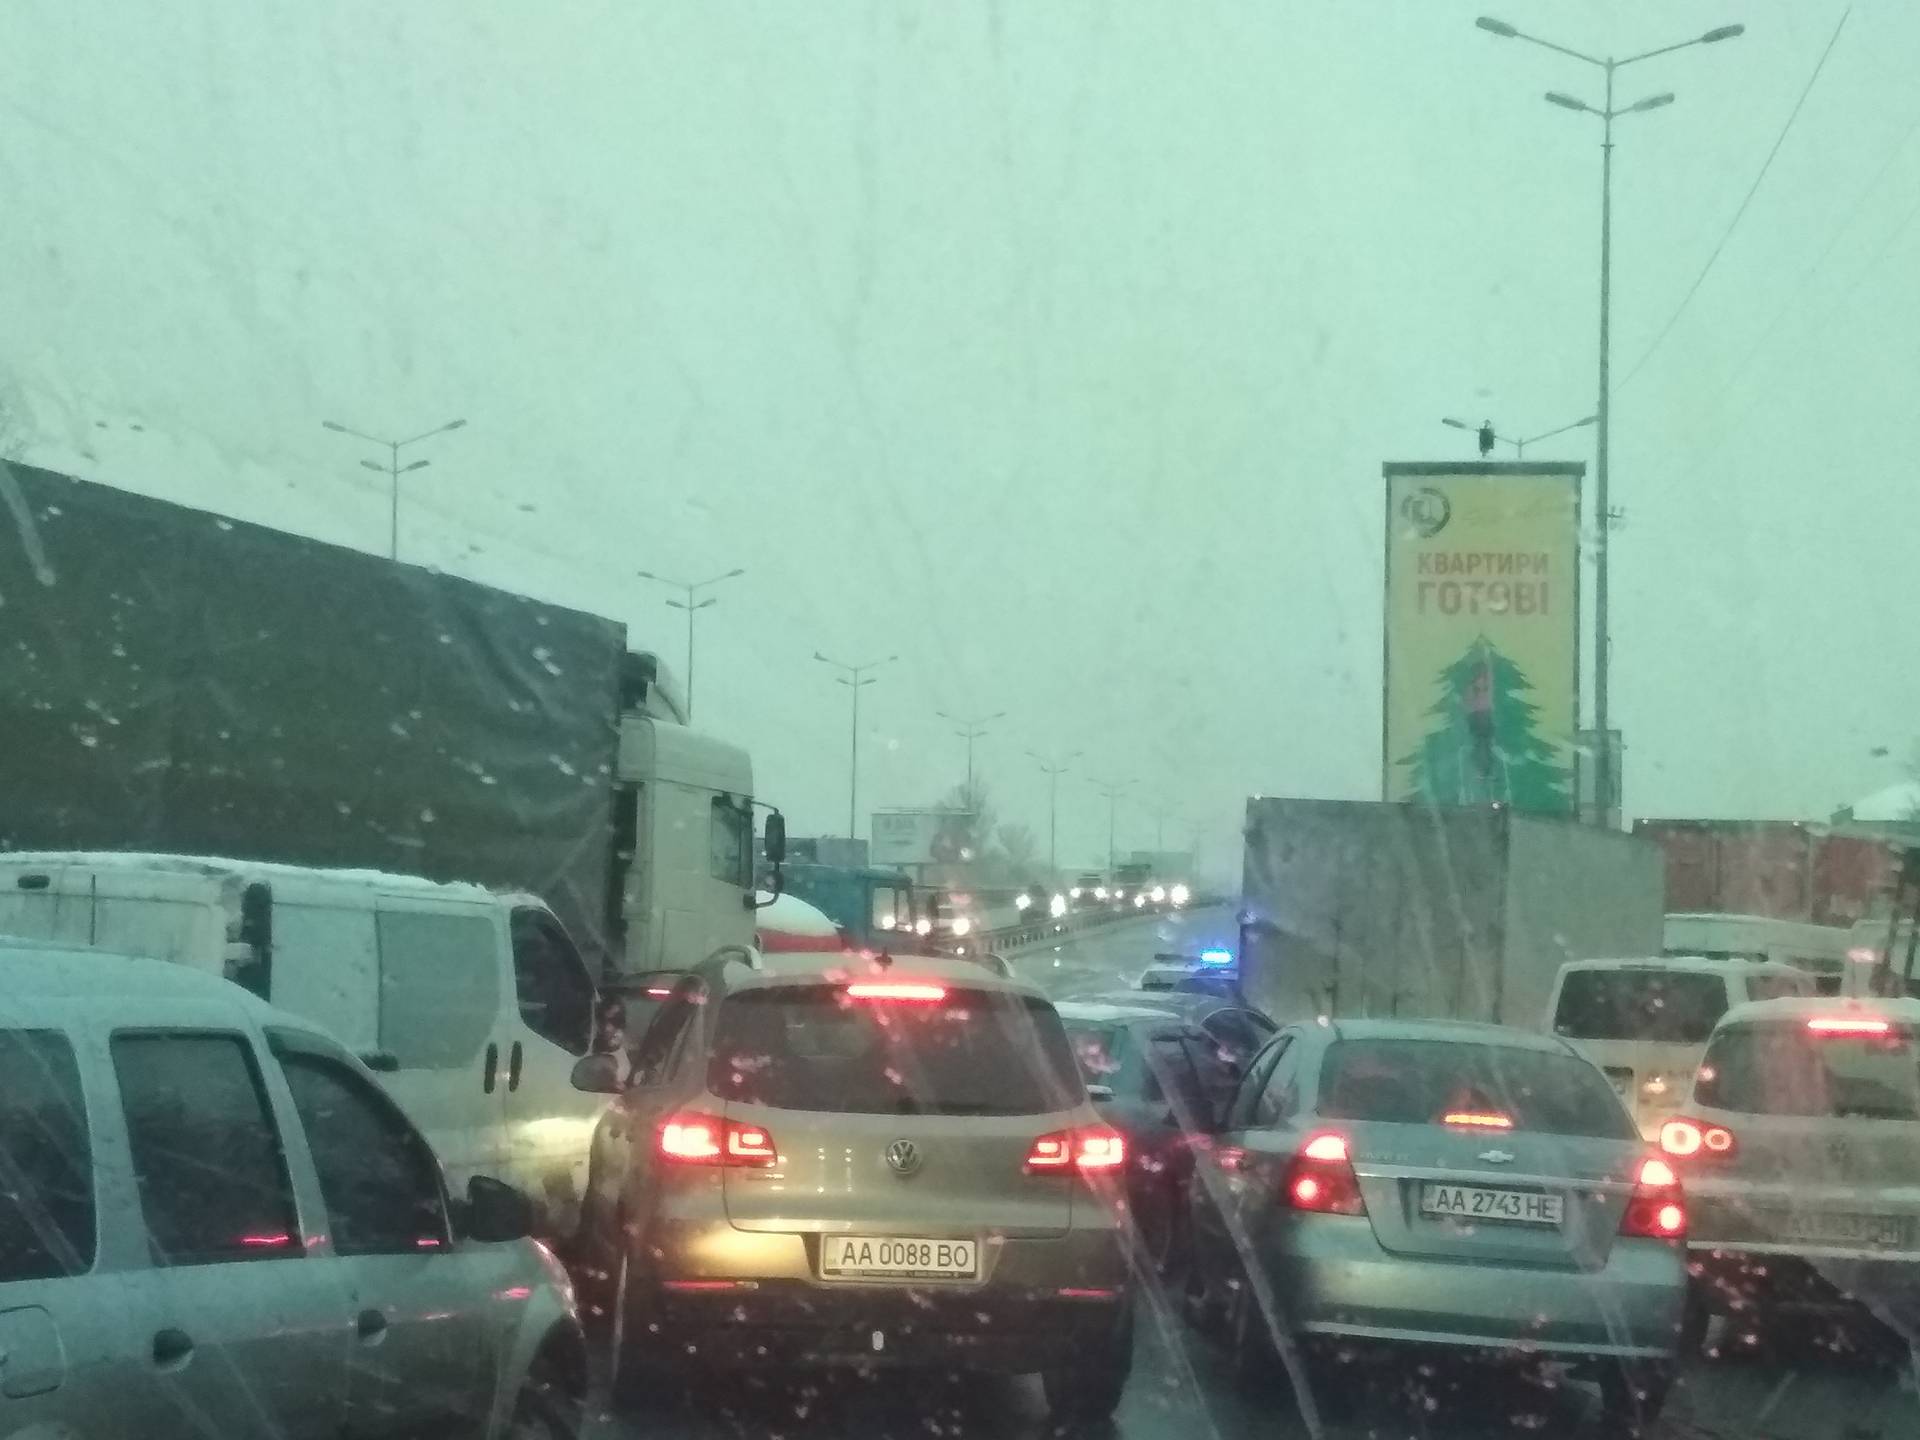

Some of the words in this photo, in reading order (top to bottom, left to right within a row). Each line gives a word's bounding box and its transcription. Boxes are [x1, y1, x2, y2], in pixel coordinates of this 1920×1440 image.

[1417, 553, 1549, 575] КВАРТИРИ
[1418, 581, 1549, 616] ГОТОВІ
[1436, 1189, 1466, 1211] AA
[1473, 1193, 1521, 1216] 2743
[1526, 1196, 1555, 1220] HE
[842, 1242, 873, 1265] AA
[879, 1243, 931, 1266] 0088
[937, 1245, 968, 1268] BO
